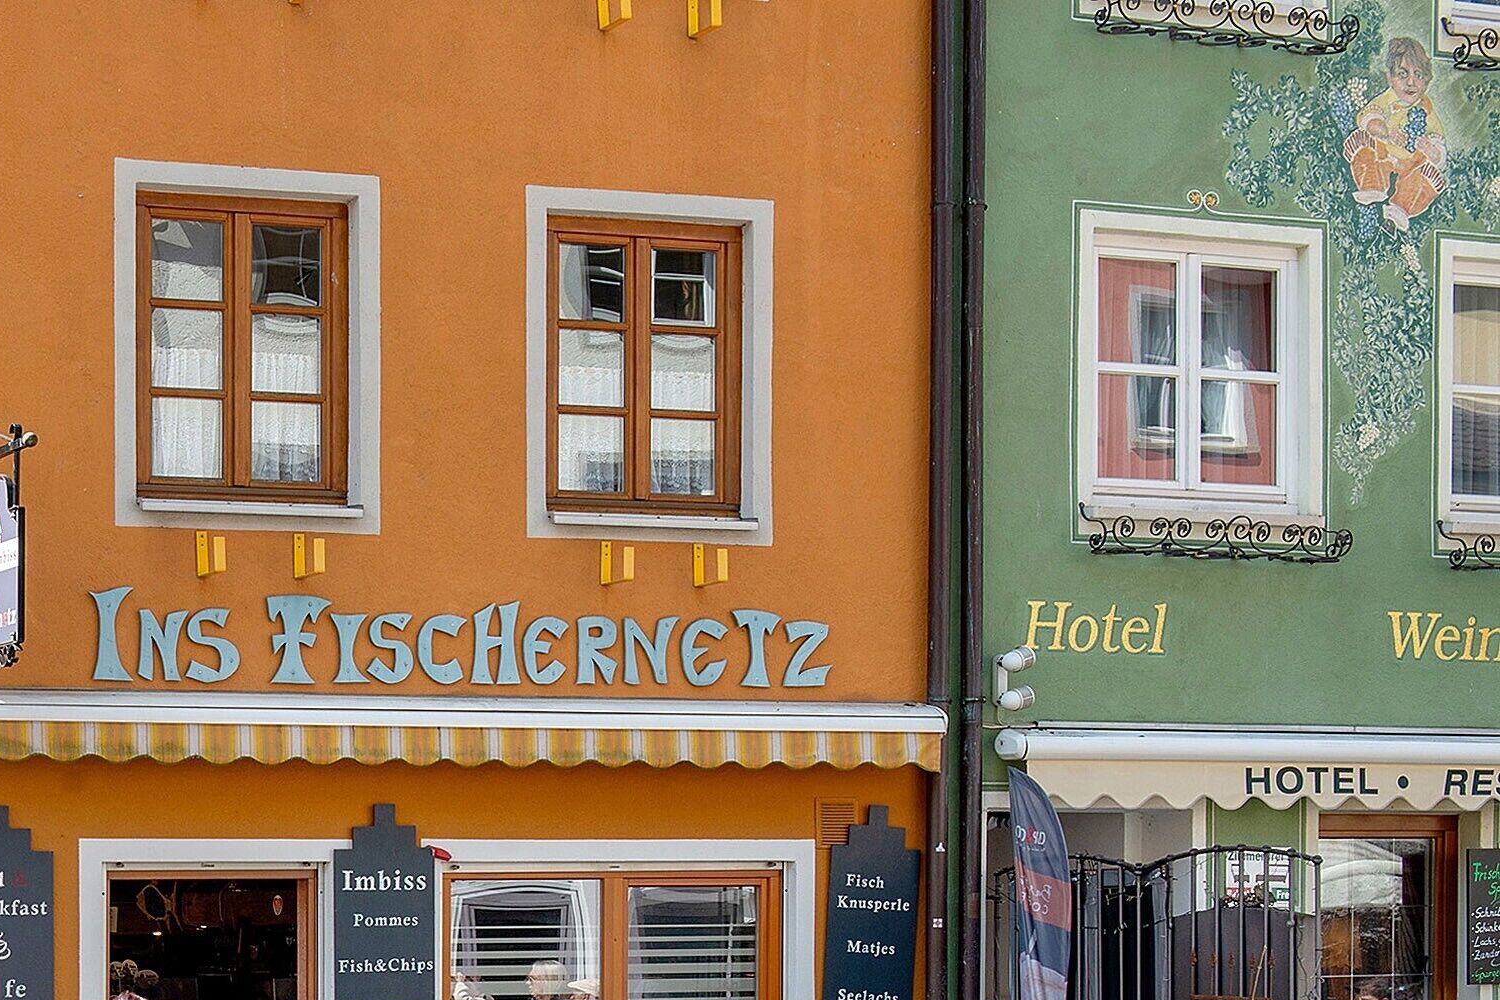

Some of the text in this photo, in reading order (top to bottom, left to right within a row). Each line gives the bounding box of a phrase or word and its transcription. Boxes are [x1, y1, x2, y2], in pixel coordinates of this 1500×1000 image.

[1025, 600, 1168, 654] Hotel
[1387, 611, 1500, 661] Wein
[1245, 766, 1500, 796] HOTEL RE
[341, 869, 428, 891] Imbiss
[845, 873, 885, 889] Fisch
[836, 895, 910, 912] Knusperle
[353, 913, 419, 927] Pommes
[847, 939, 896, 957] Matjes
[338, 957, 434, 974] Fish&Chips
